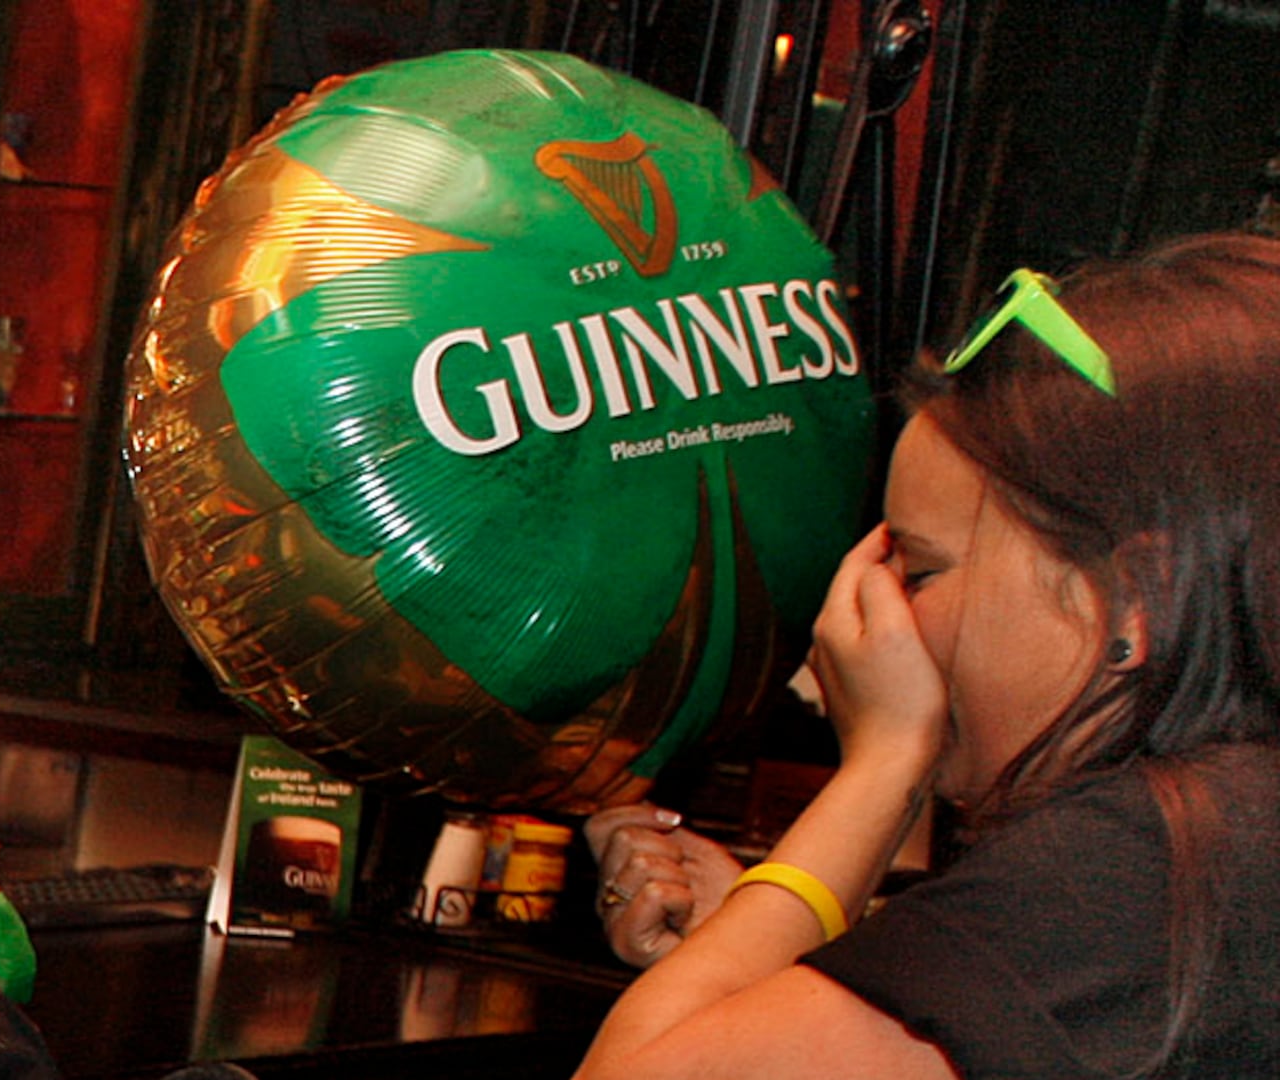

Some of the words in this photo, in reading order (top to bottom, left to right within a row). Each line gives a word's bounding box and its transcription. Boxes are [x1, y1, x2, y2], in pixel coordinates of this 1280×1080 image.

[680, 239, 728, 262] 1759
[411, 278, 861, 457] GUINNESS
[609, 437, 665, 463] Please
[666, 424, 711, 450] Drink
